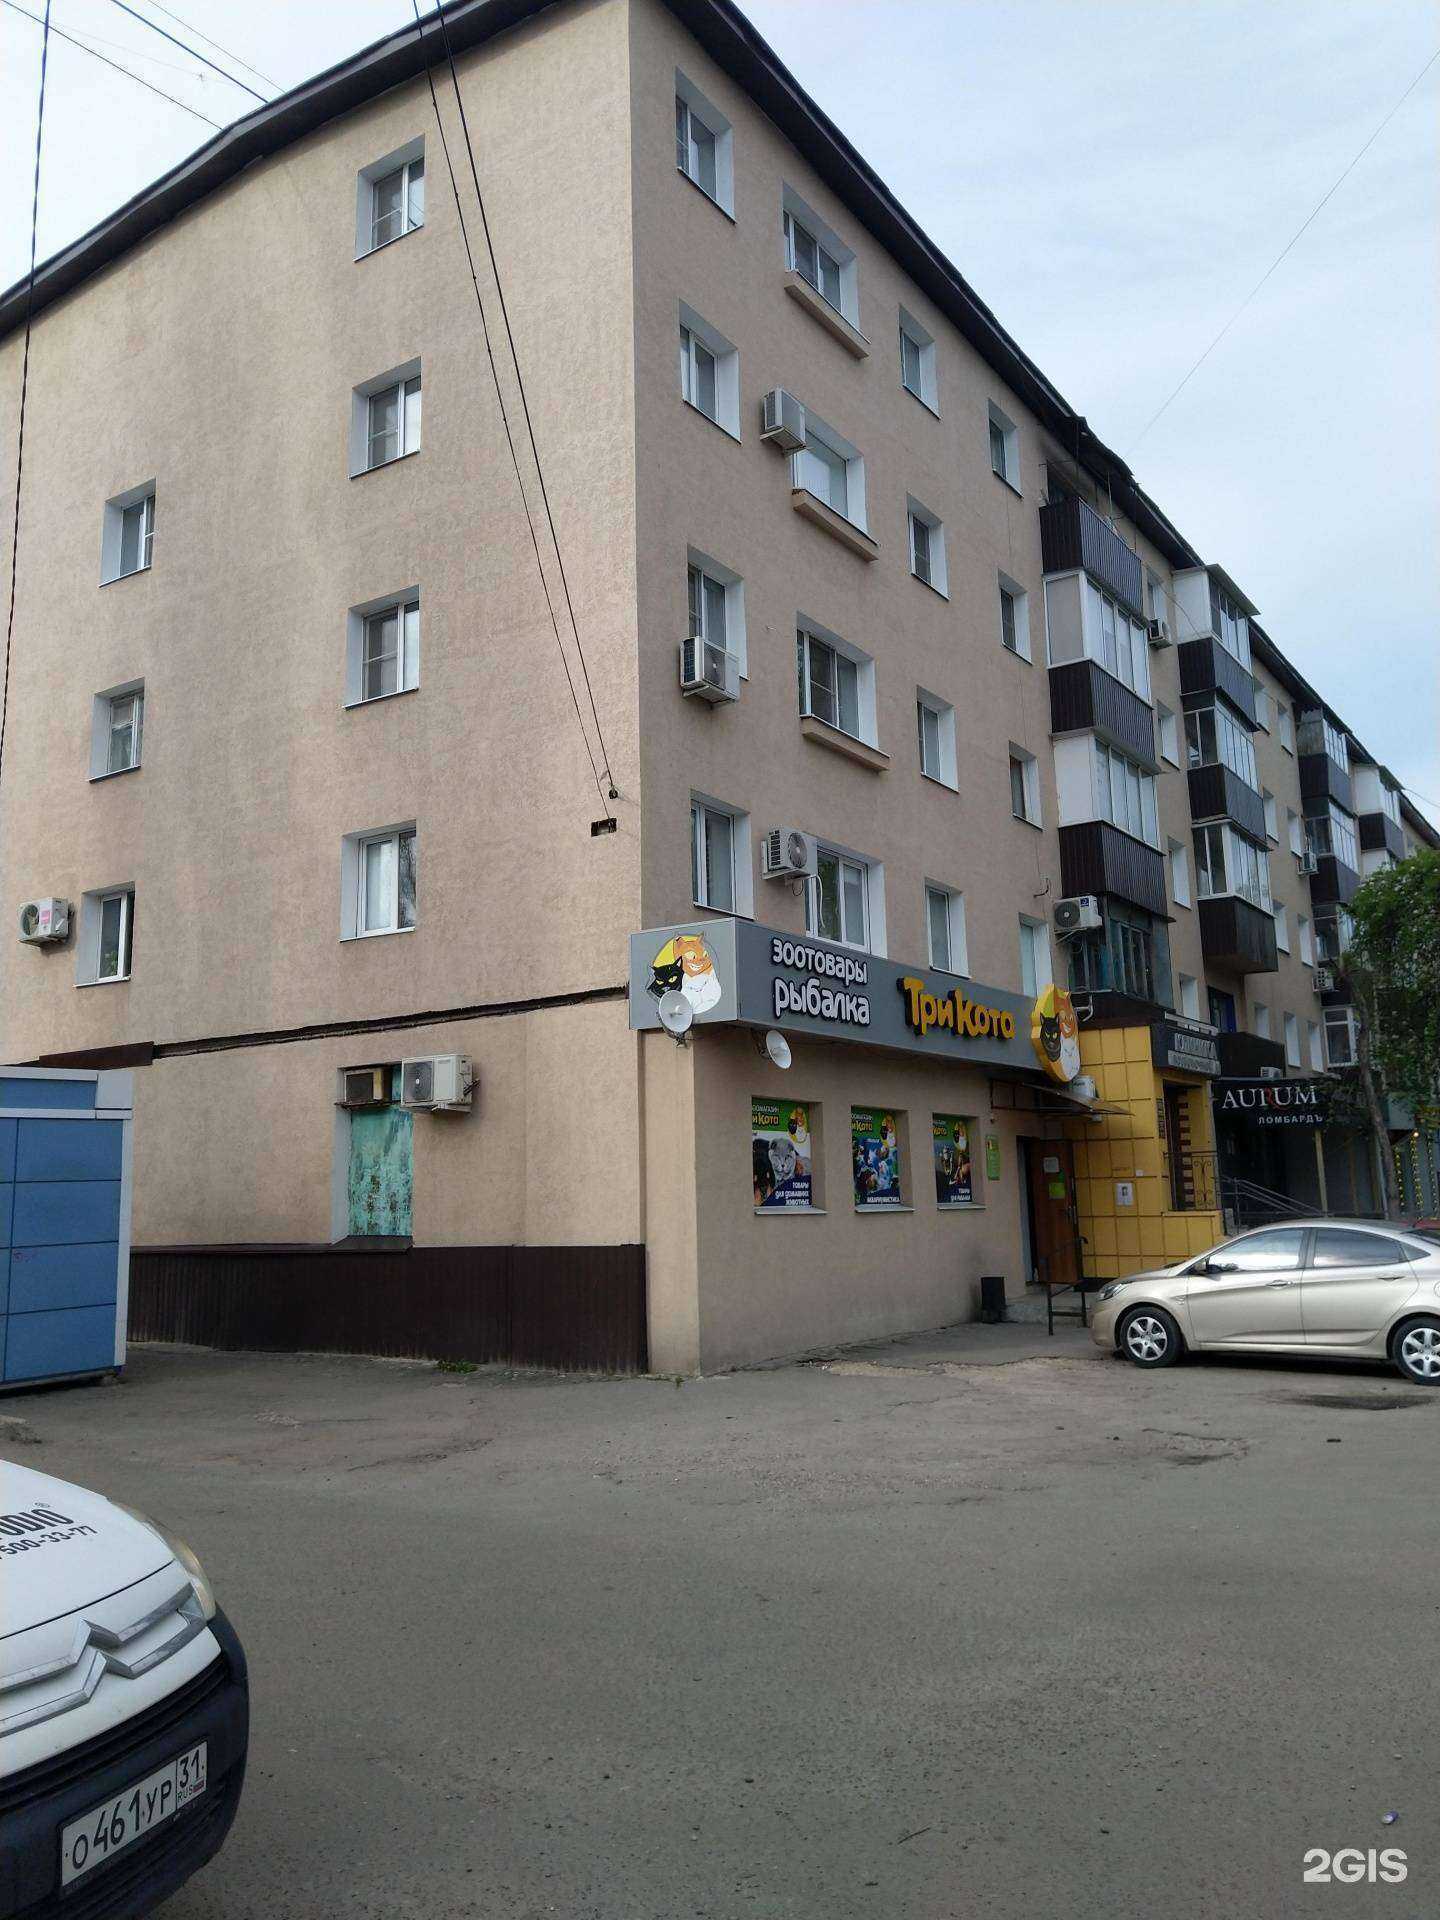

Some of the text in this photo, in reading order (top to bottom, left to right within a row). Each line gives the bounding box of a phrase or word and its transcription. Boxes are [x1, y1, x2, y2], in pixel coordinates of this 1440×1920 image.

[772, 939, 868, 986] зоотовары
[774, 978, 870, 1025] рыбалка
[1221, 1085, 1318, 1110] AURUM
[1258, 1114, 1323, 1125] ЛОМБАРДЪ
[179, 1749, 200, 1789] 31
[177, 1784, 194, 1803] RUS
